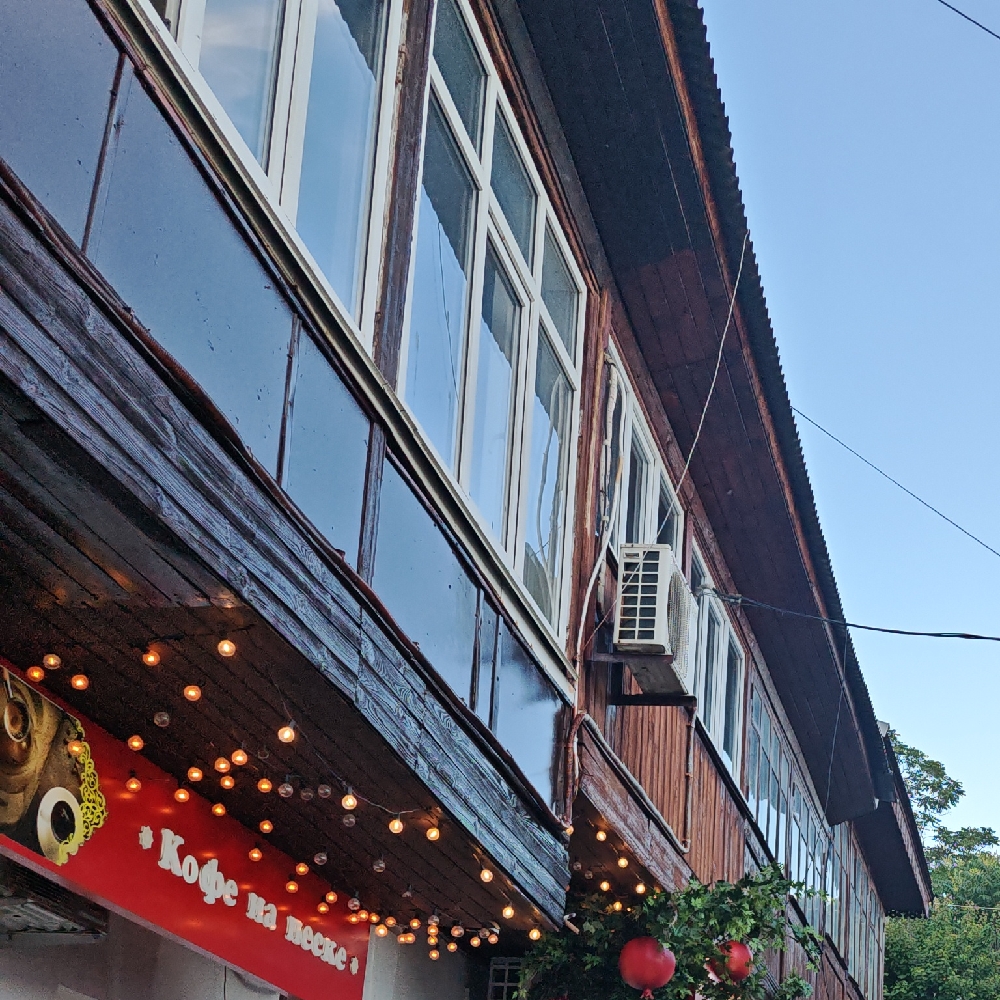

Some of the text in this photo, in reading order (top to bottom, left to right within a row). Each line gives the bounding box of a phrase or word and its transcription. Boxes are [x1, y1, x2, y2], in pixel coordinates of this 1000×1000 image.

[158, 828, 347, 970] Кофе на песке
